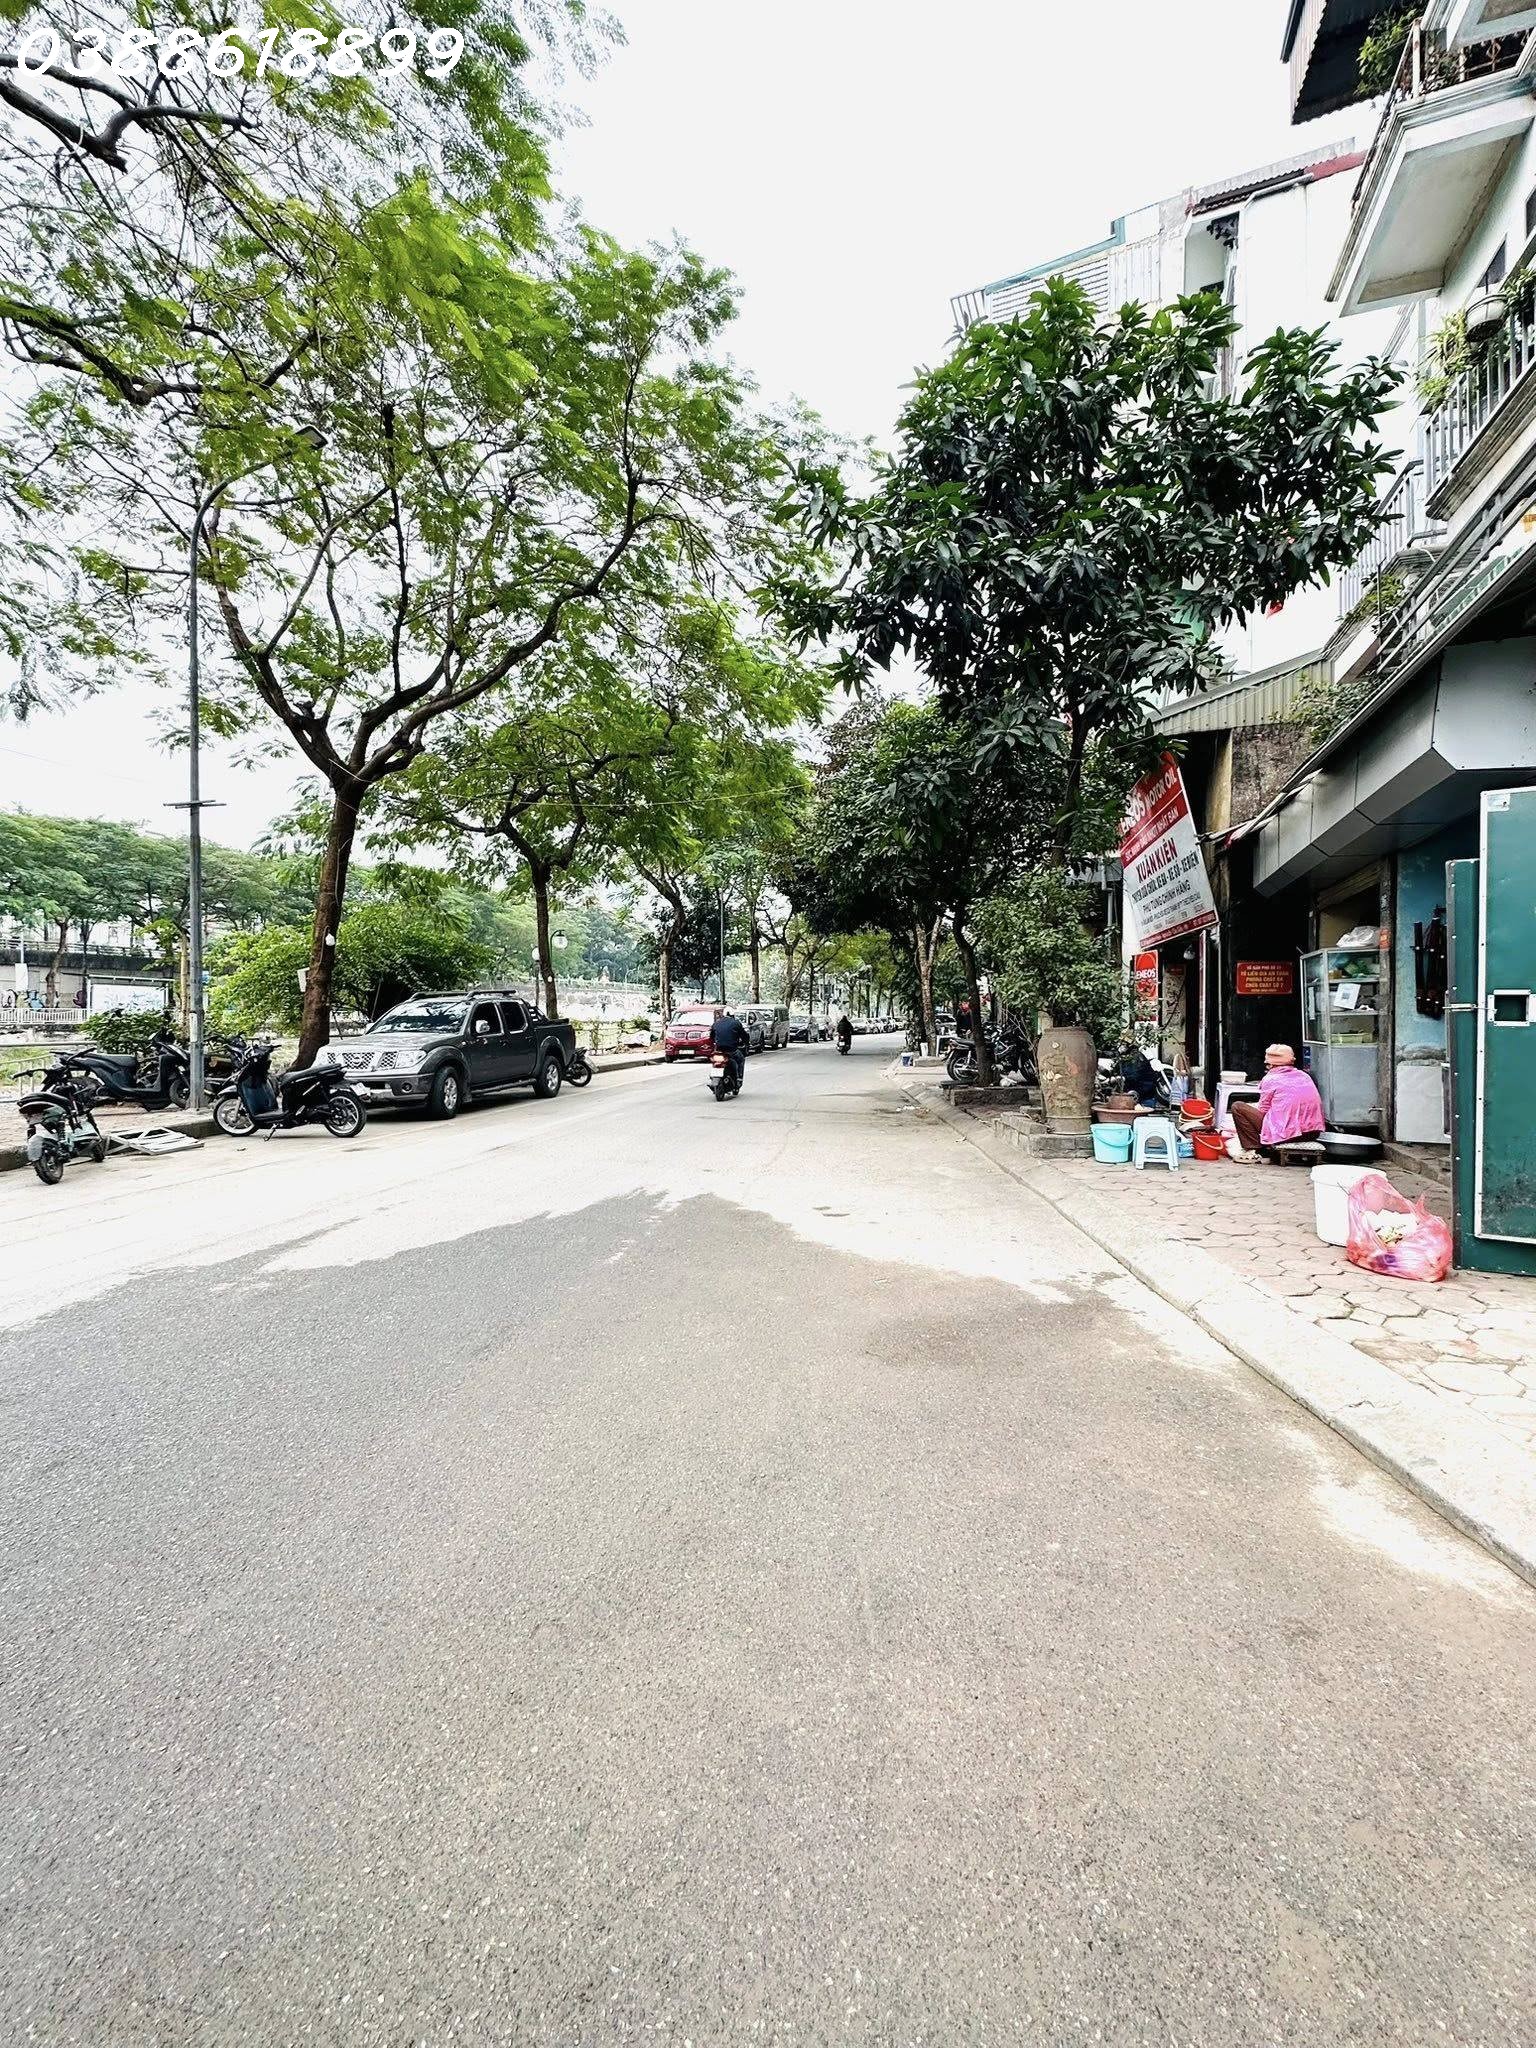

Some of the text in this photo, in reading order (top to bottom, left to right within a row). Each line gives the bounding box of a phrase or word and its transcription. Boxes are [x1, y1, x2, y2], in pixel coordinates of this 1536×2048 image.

[1145, 782, 1167, 808] MOTOR
[1165, 768, 1178, 789] OIL
[1137, 968, 1156, 980] ENEOS
